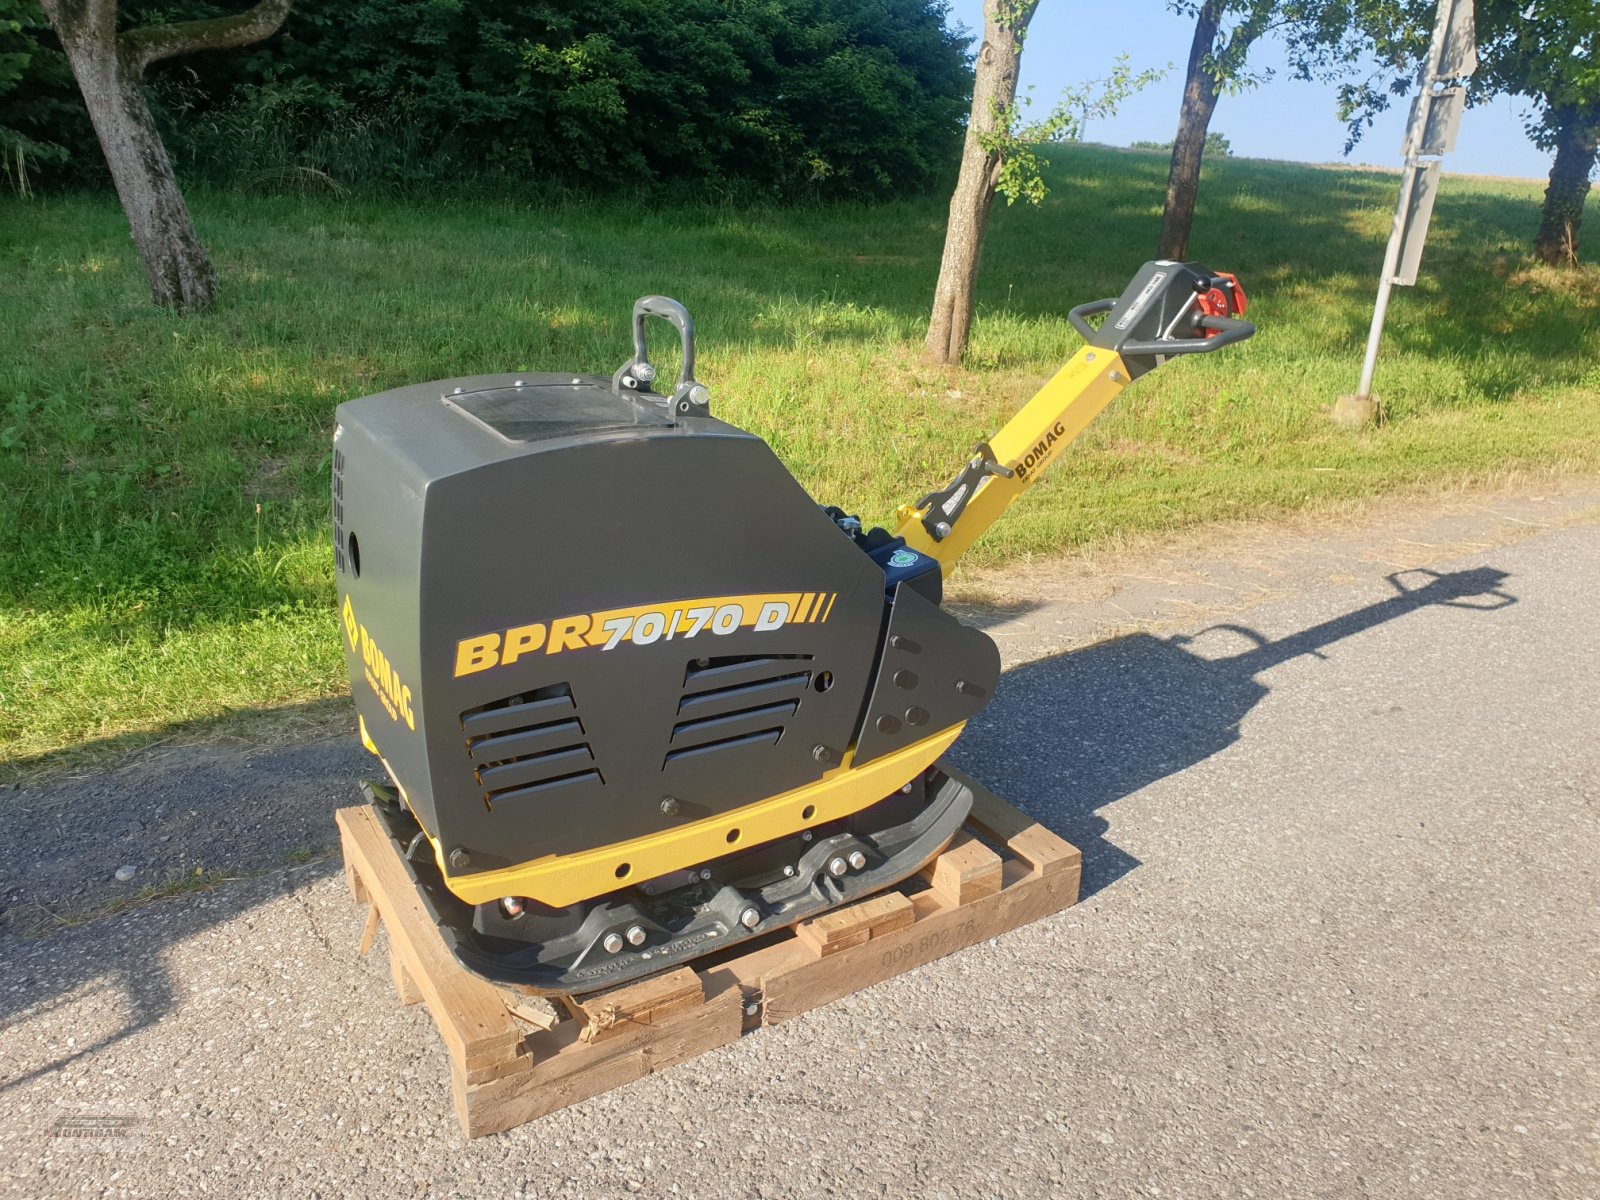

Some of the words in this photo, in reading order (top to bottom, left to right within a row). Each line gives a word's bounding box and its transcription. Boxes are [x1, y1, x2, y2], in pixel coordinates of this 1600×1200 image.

[1015, 421, 1065, 479] BOMAG
[360, 624, 415, 731] BOMAG
[454, 614, 593, 679] BPR
[602, 602, 745, 652] 70/70
[753, 601, 790, 633] D
